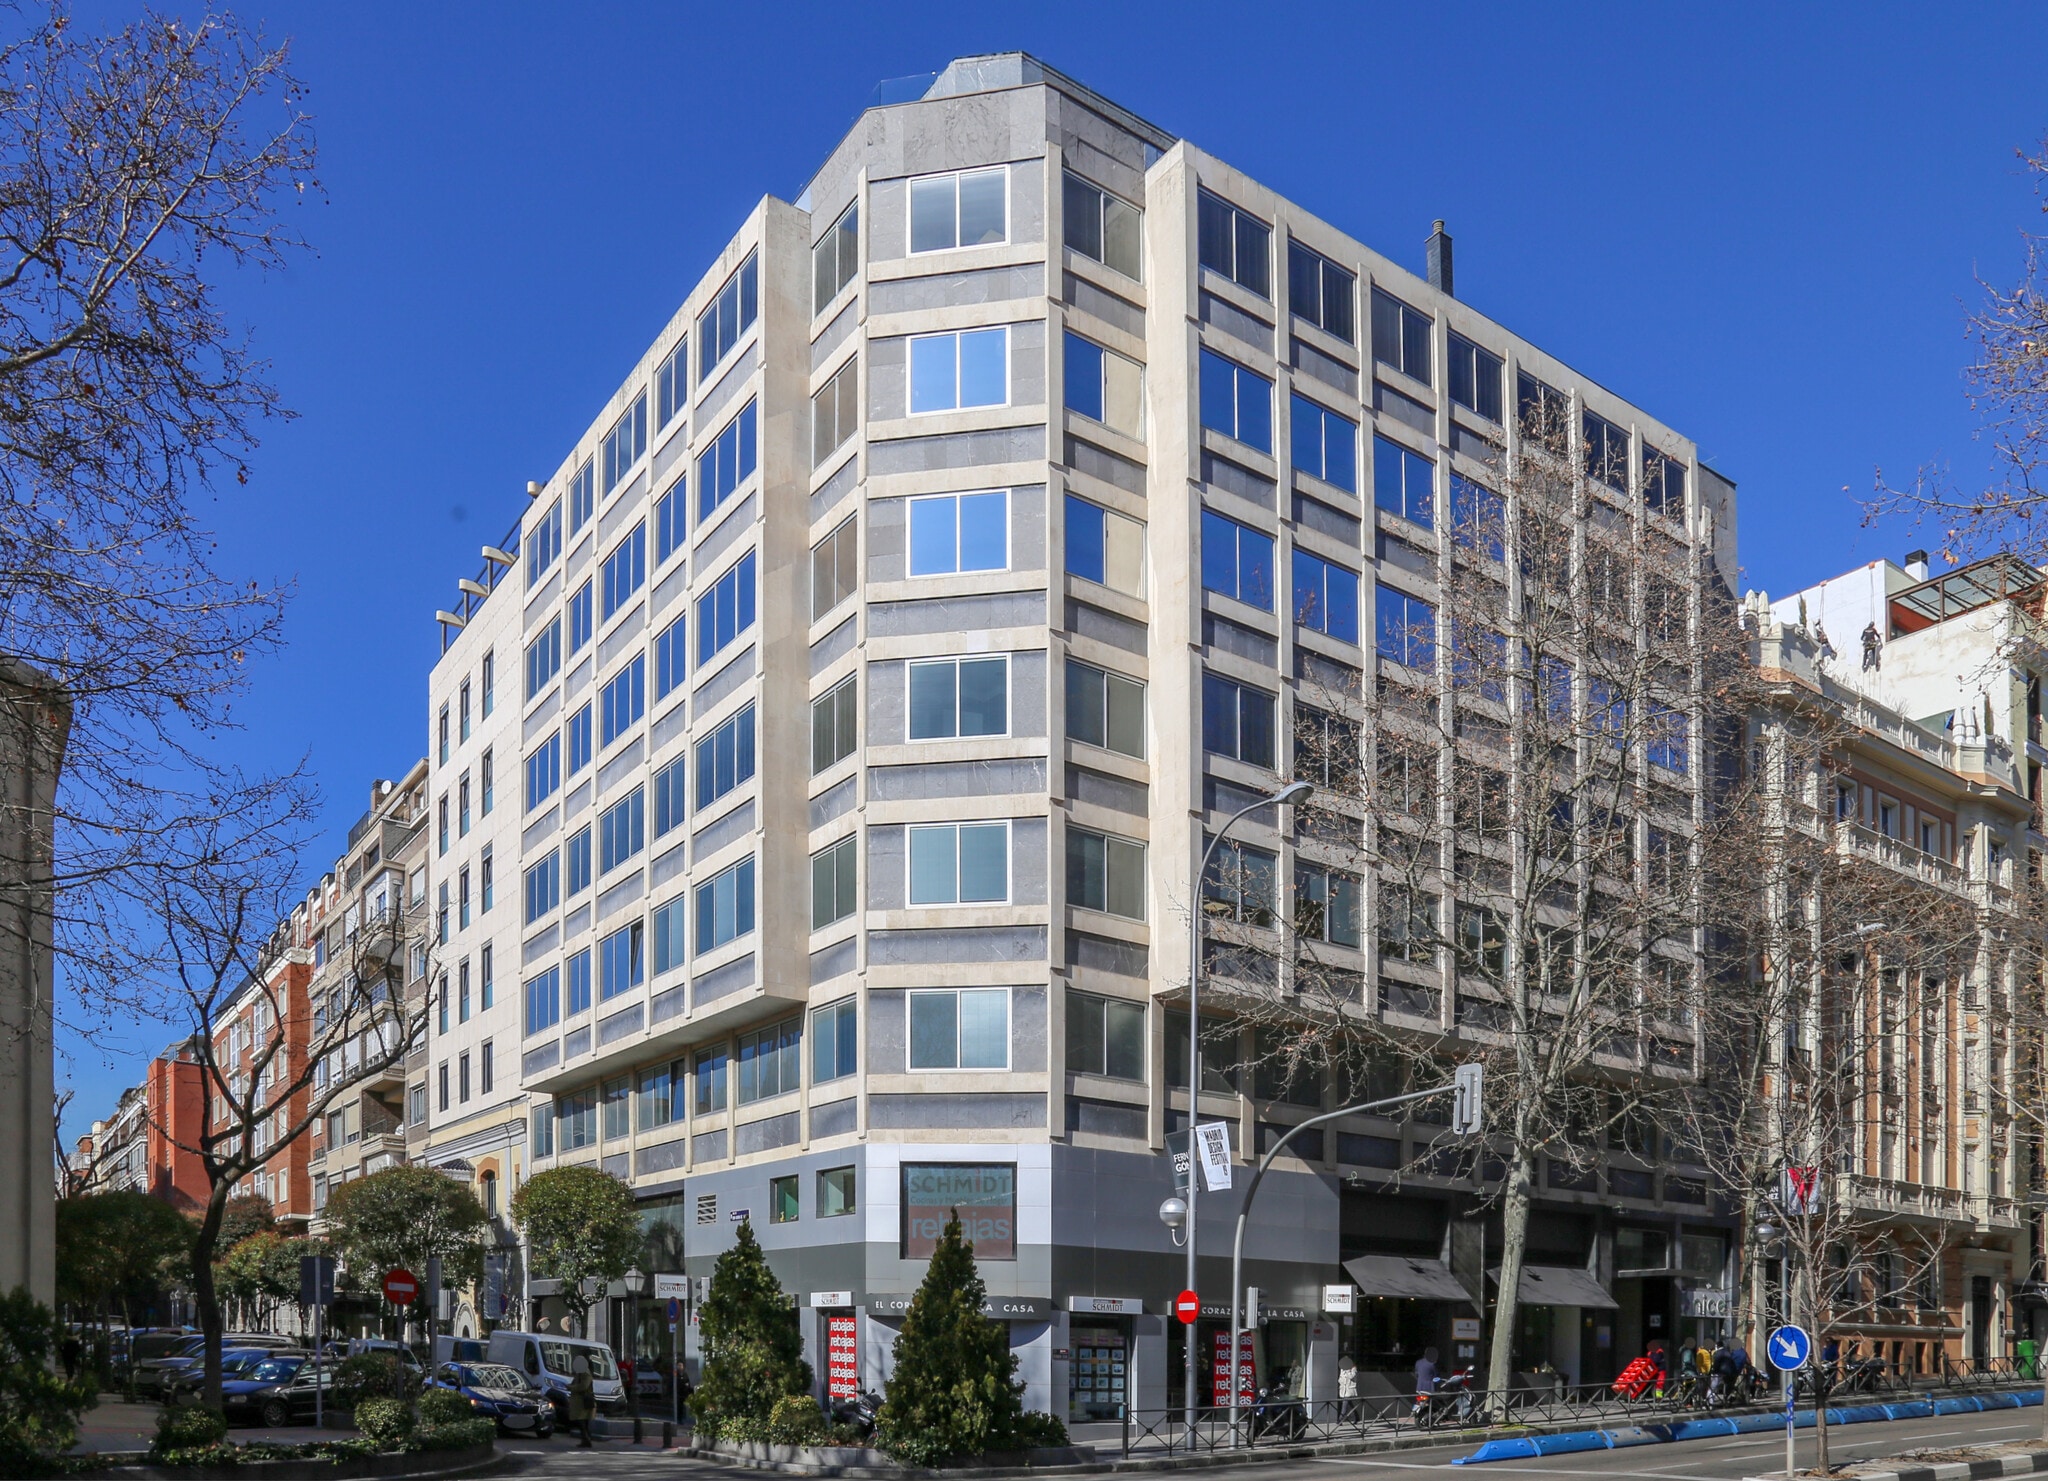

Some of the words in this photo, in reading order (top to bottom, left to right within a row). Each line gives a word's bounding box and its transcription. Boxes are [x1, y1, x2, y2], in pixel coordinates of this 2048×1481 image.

[1204, 1129, 1223, 1142] MADRID
[1208, 1141, 1225, 1154] DESIGN
[875, 1301, 884, 1309] EL
[1003, 1304, 1035, 1313] CASA
[1092, 1303, 1123, 1312] SCHMIDT
[1693, 1294, 1726, 1316] nice
[1202, 1306, 1246, 1316] CORAZN
[1283, 1310, 1305, 1318] CASA
[831, 1319, 855, 1334] rebajas
[831, 1334, 855, 1349] rebajas
[1216, 1332, 1252, 1345] rebas
[831, 1350, 855, 1365] rebajas
[1216, 1347, 1252, 1360] rebas
[831, 1365, 855, 1381] rebajas
[1216, 1363, 1252, 1375] rebas
[831, 1381, 855, 1396] rebajas
